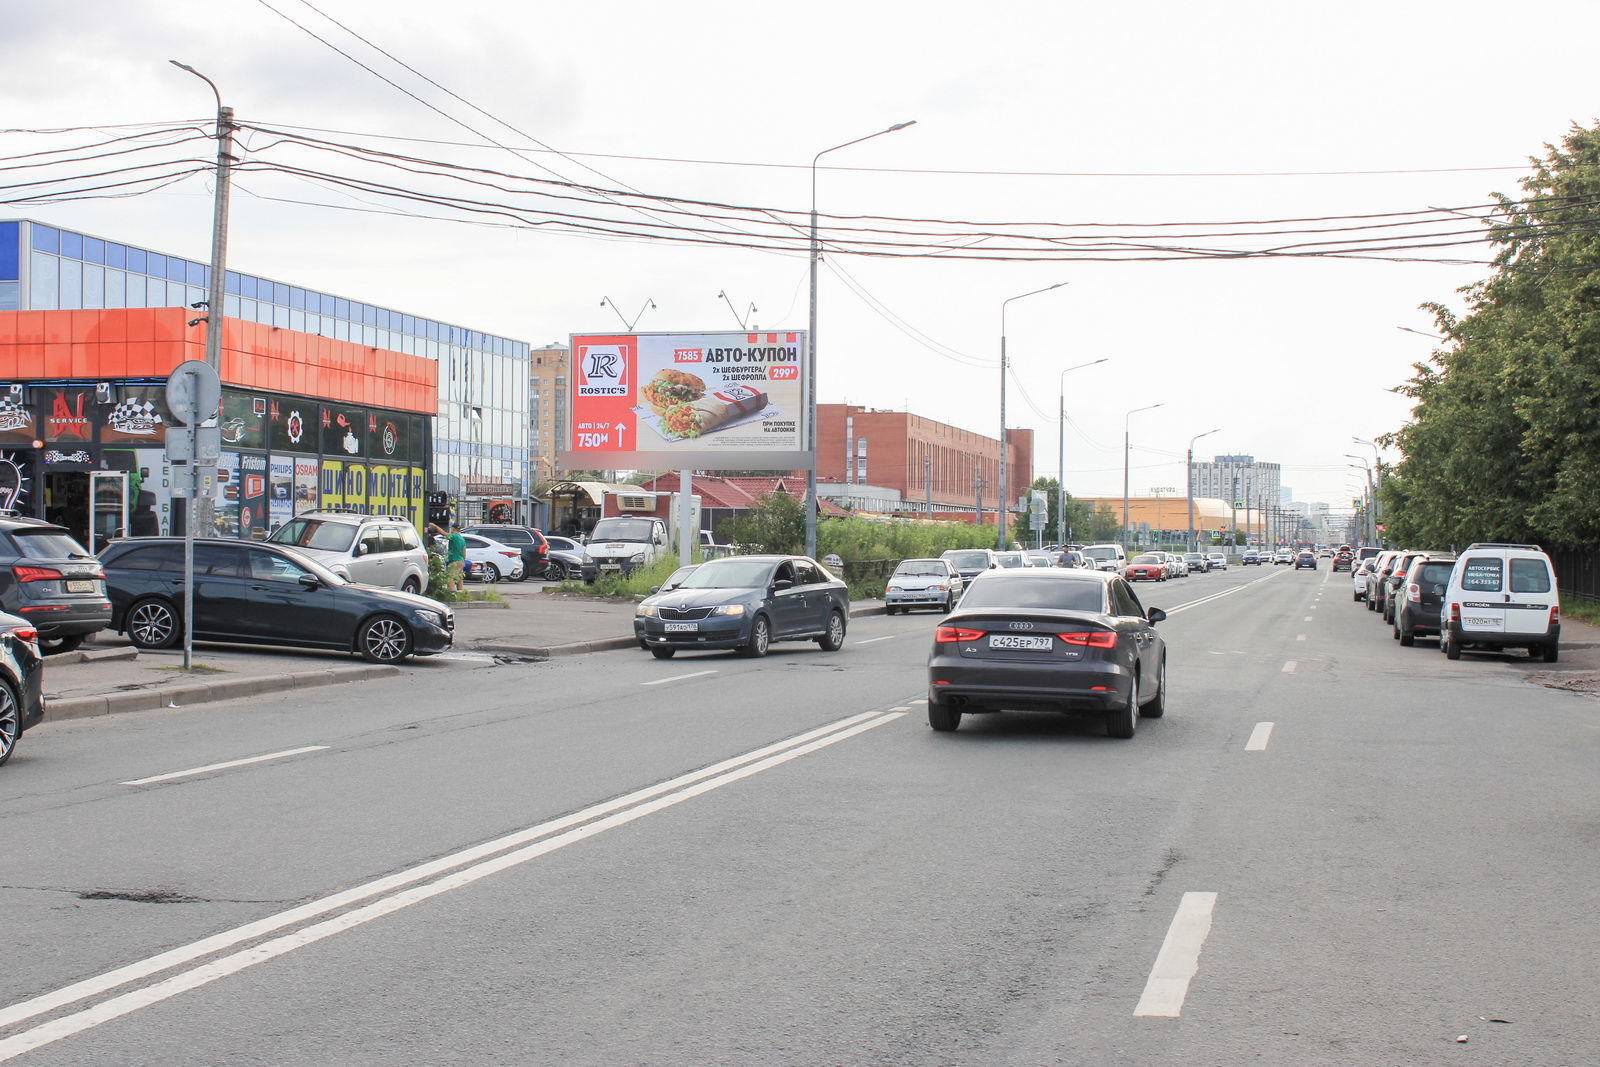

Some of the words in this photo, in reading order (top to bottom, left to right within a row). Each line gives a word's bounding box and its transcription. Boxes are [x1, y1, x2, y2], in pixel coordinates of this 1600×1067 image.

[677, 351, 699, 361] 7585
[705, 346, 797, 363] АВТО-КУПОН
[580, 387, 626, 395] ROSTIC'S
[270, 463, 293, 475] PHILIPS
[295, 463, 318, 477] OSRAM
[1034, 637, 1050, 646] 797
